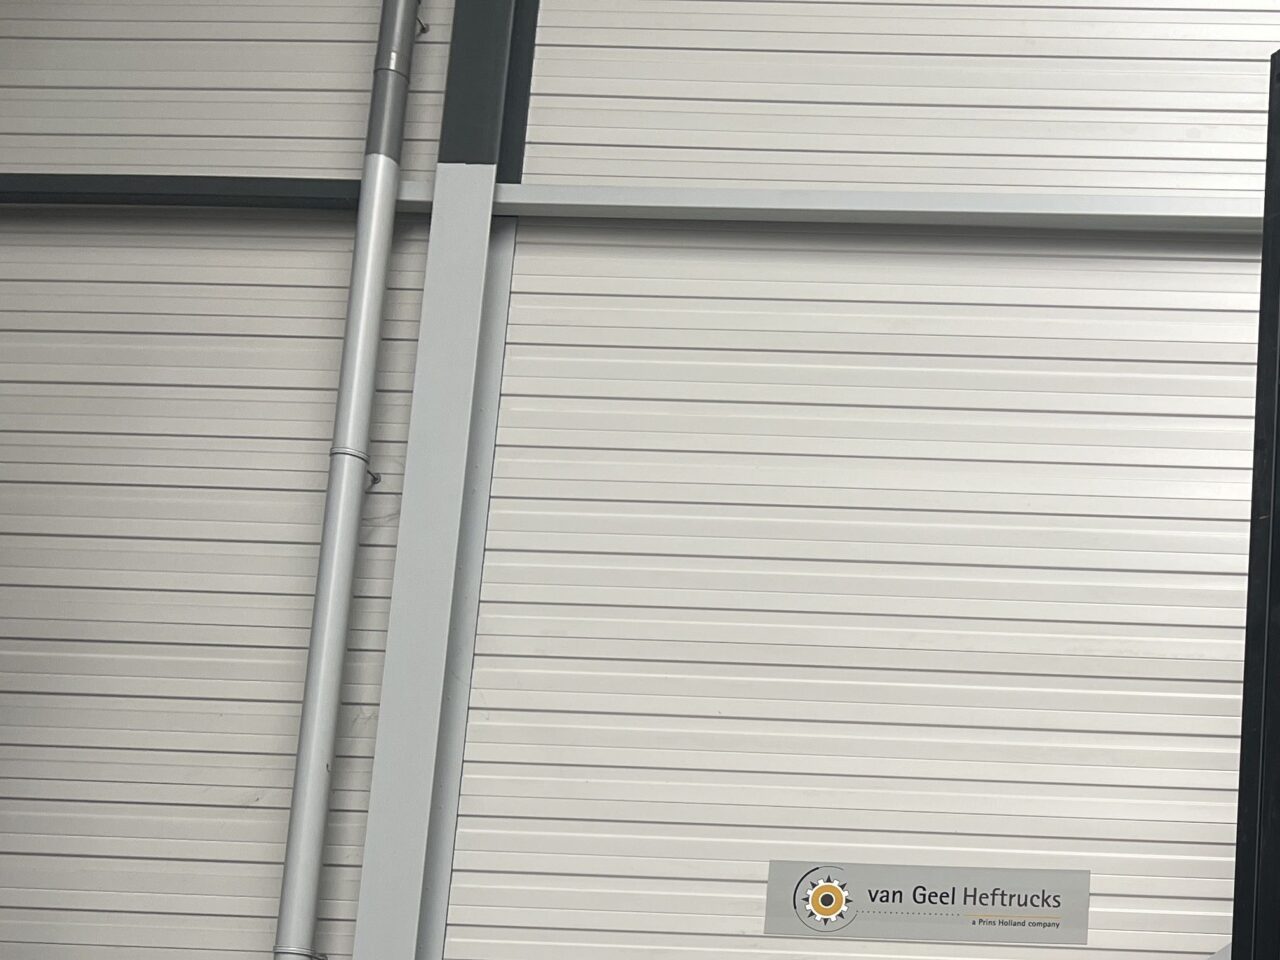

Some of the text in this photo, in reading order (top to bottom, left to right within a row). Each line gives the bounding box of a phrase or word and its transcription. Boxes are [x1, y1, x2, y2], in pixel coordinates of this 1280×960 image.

[867, 885, 1061, 909] van Geel Heftrucks
[978, 918, 997, 927] Prins
[998, 919, 1027, 928] Holland
[1028, 921, 1060, 929] company
